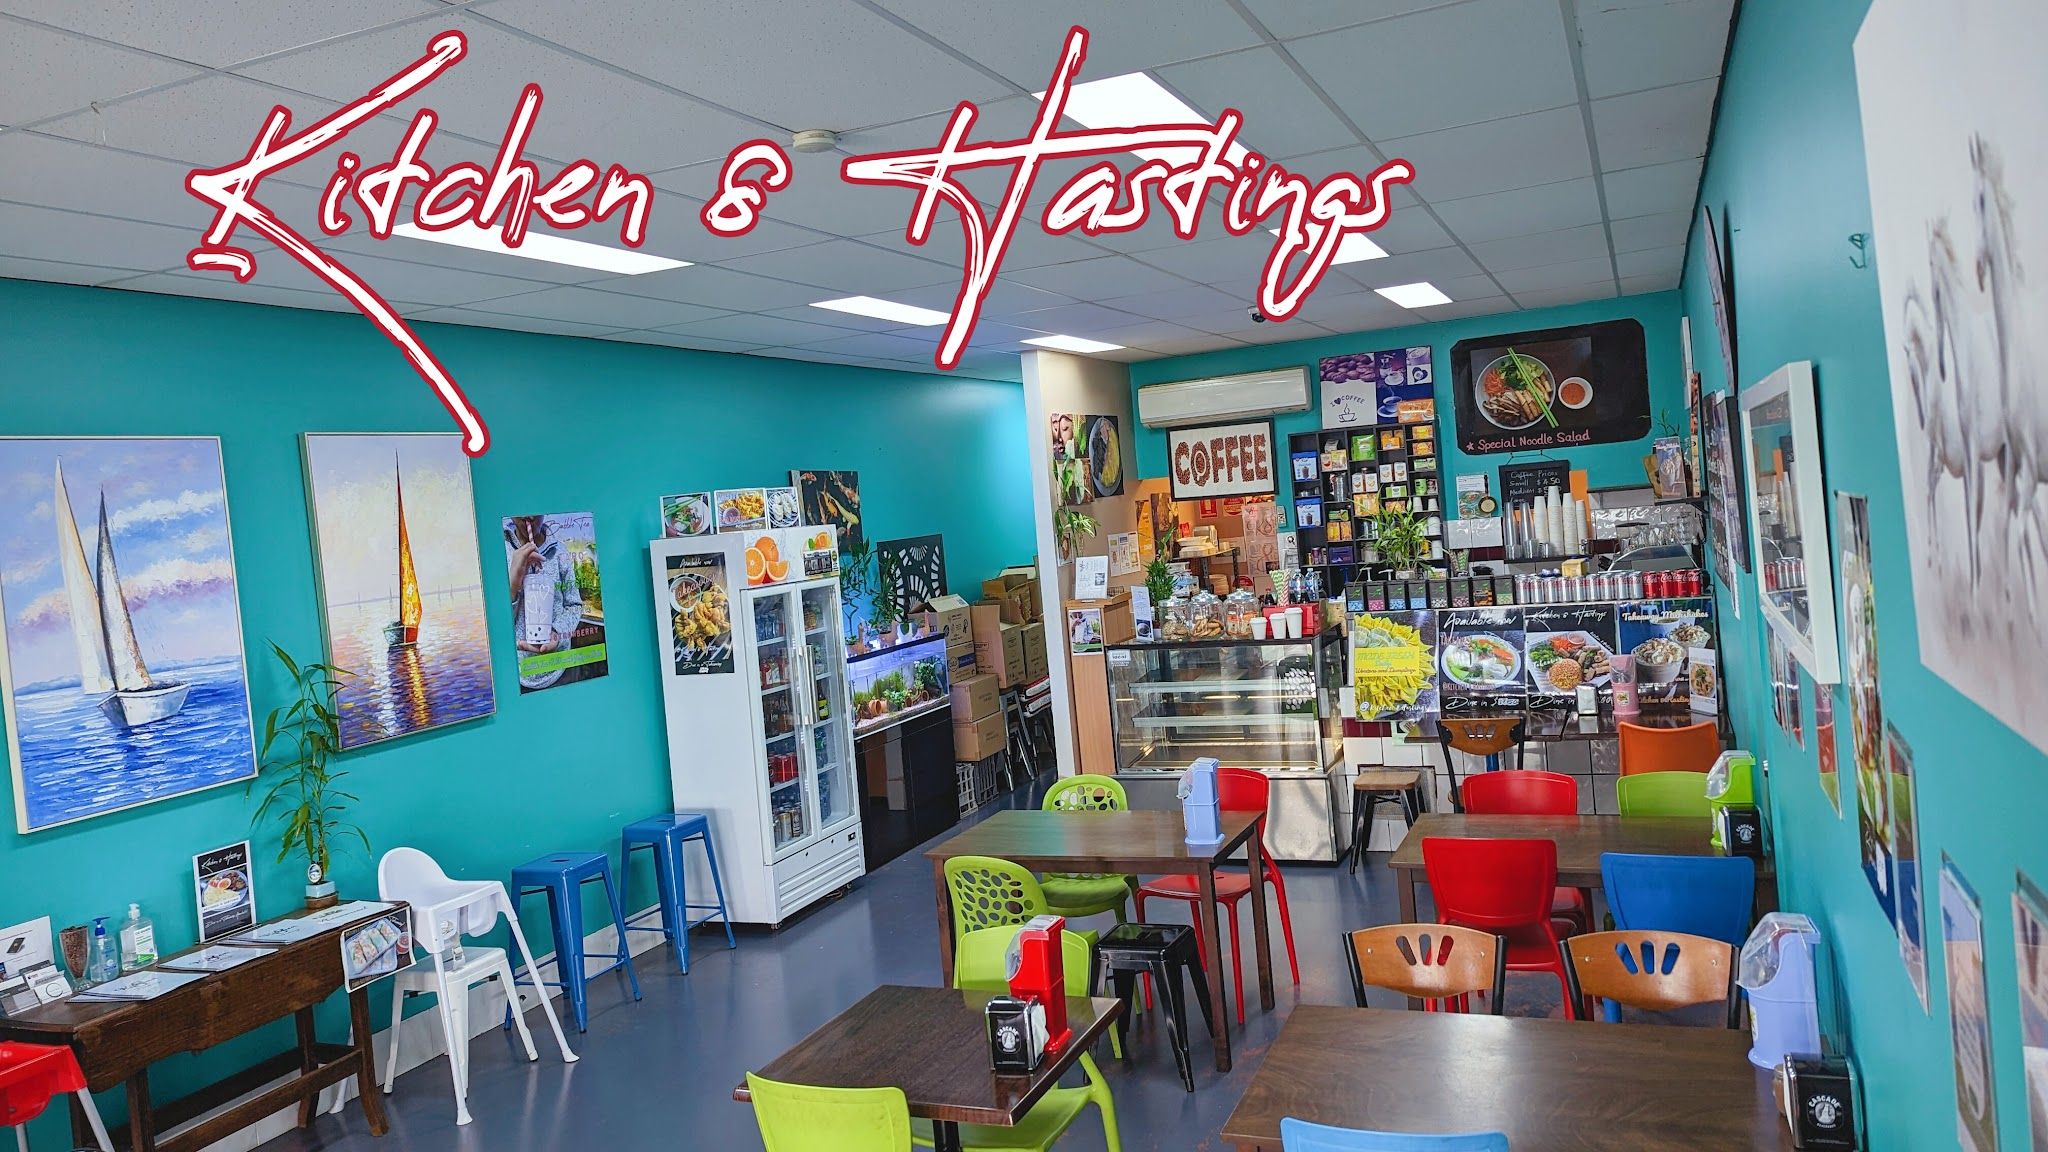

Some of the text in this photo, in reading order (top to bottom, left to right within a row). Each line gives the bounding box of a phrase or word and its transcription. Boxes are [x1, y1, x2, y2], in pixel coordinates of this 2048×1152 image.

[1341, 394, 1366, 405] COFFEE
[1477, 429, 1591, 453] Special Noodle Salad
[1174, 433, 1269, 487] COFFEE
[1622, 611, 1660, 622] Takeaway
[1443, 611, 1492, 642] Available
[1445, 696, 1478, 710] Dine
[1481, 698, 1488, 706] in
[1808, 1095, 1842, 1108] CASCADE
